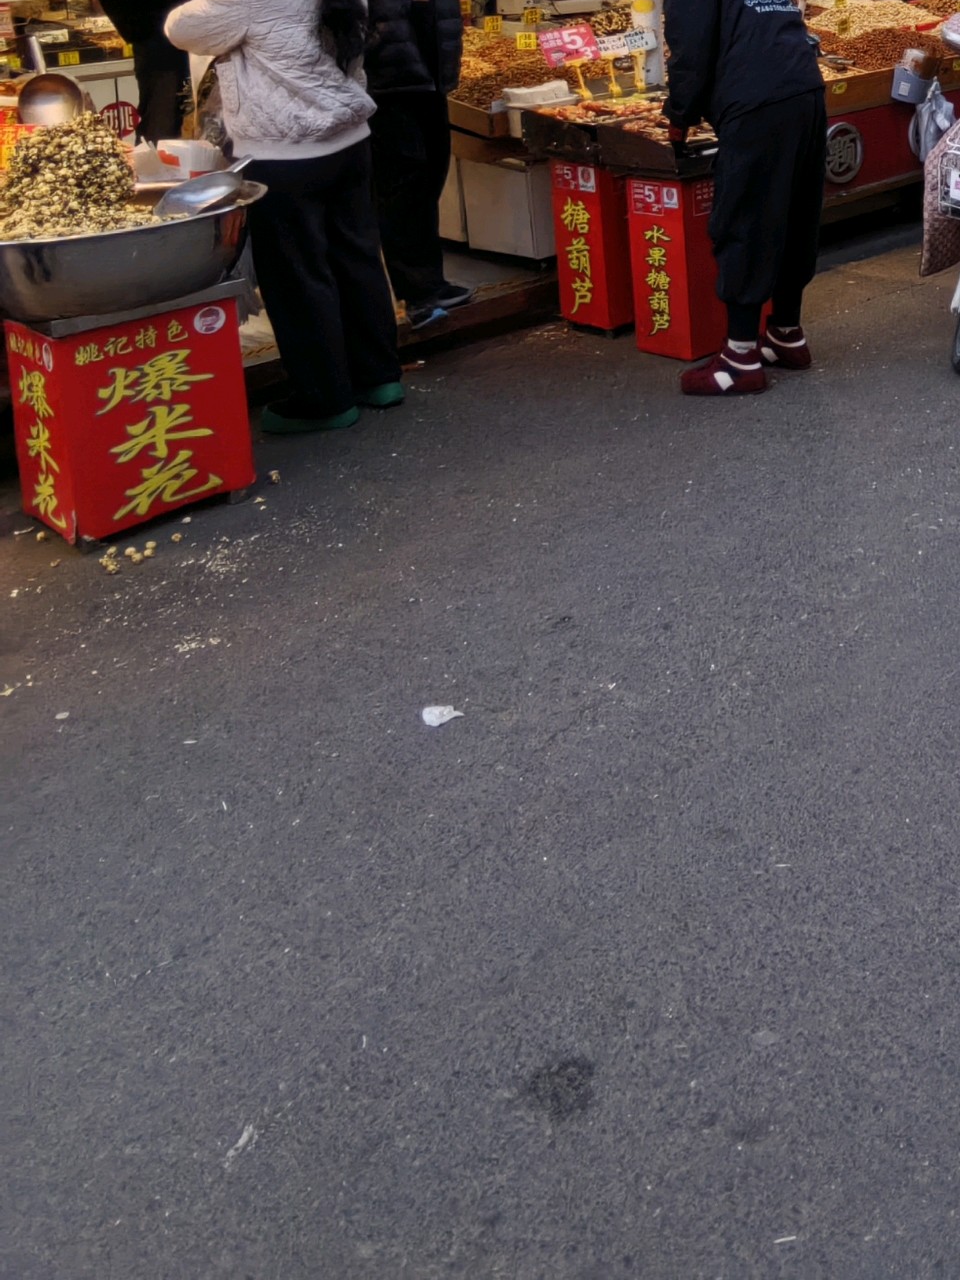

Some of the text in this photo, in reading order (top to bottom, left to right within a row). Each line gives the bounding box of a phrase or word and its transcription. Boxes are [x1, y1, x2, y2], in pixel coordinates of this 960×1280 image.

[560, 196, 593, 314] 糖葫芦
[643, 224, 672, 335] 水果糖葫芦
[75, 320, 188, 366] 姚记特色
[18, 364, 67, 529] 爆米花
[95, 349, 224, 520] 爆米花
